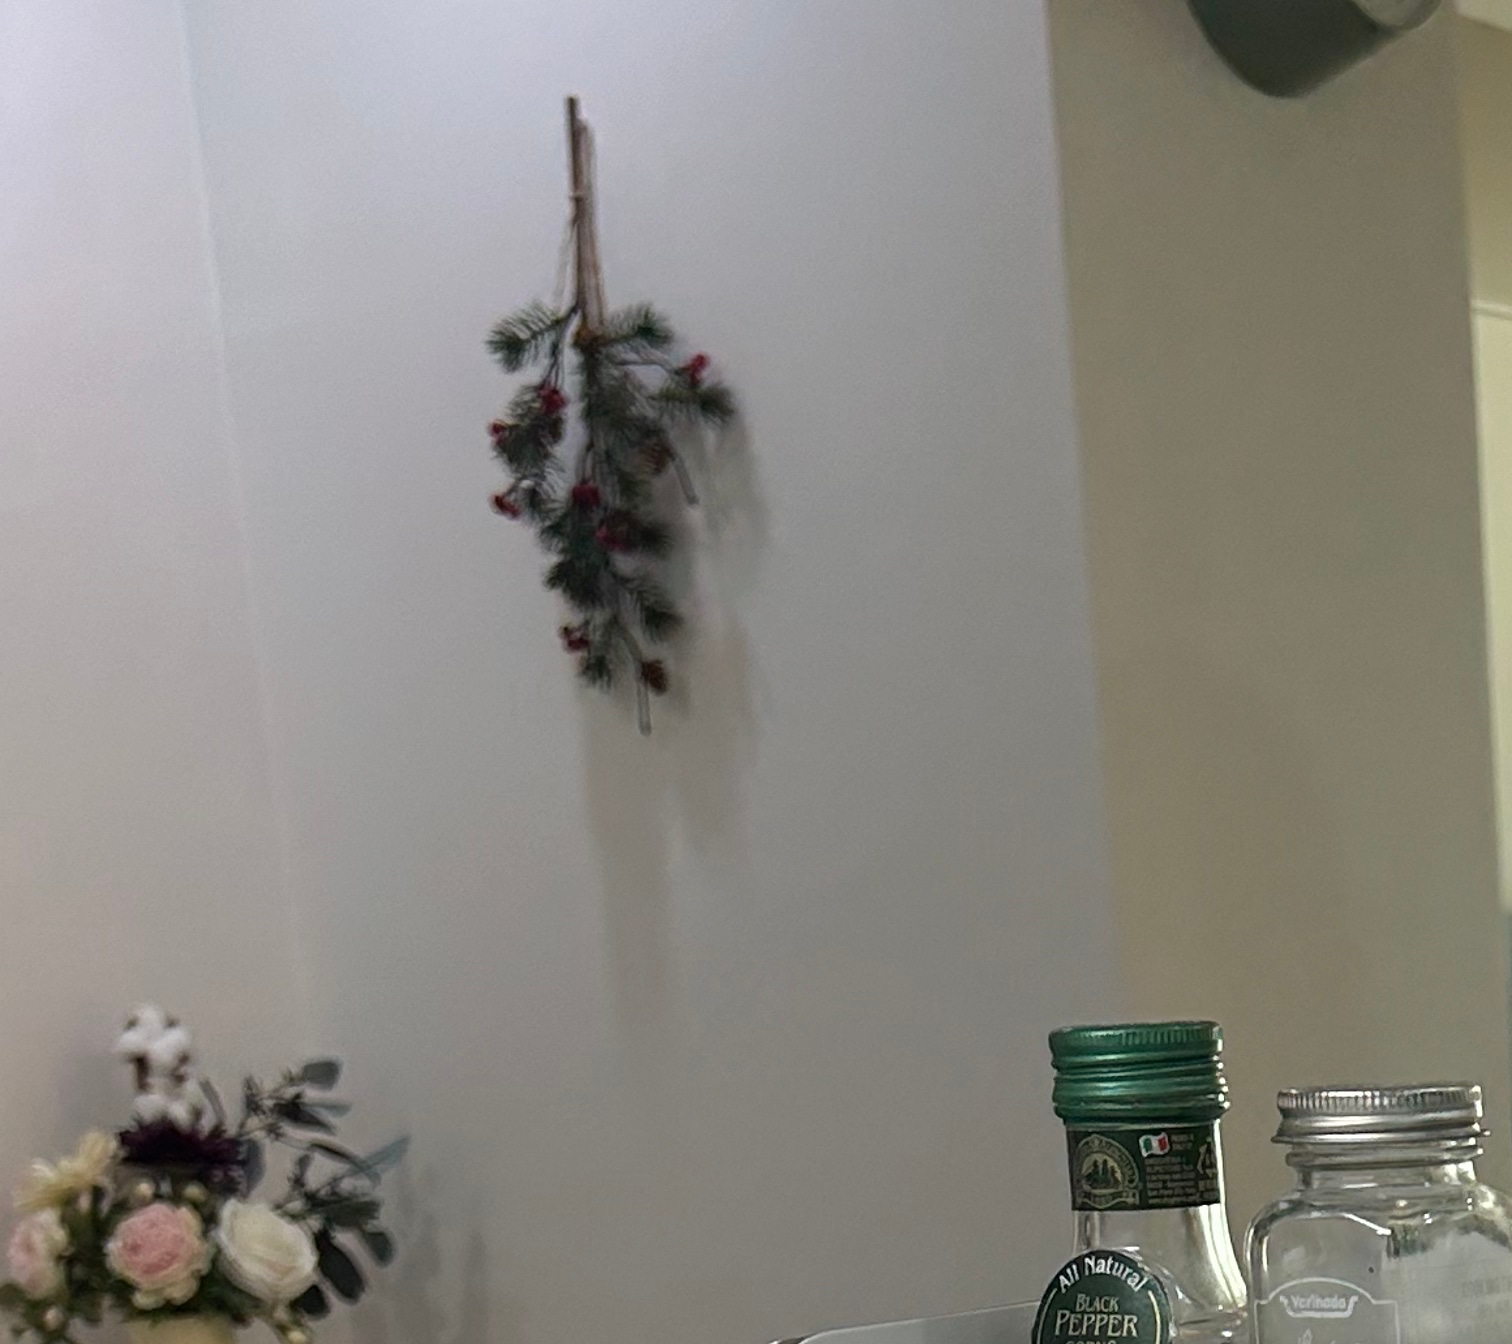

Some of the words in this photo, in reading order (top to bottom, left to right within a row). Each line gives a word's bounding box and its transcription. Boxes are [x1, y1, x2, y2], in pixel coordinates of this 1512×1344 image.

[1058, 1264, 1081, 1293] All
[1084, 1255, 1150, 1292] Natural
[1076, 1293, 1119, 1313] BLACK
[1055, 1309, 1138, 1337] PEPPER
